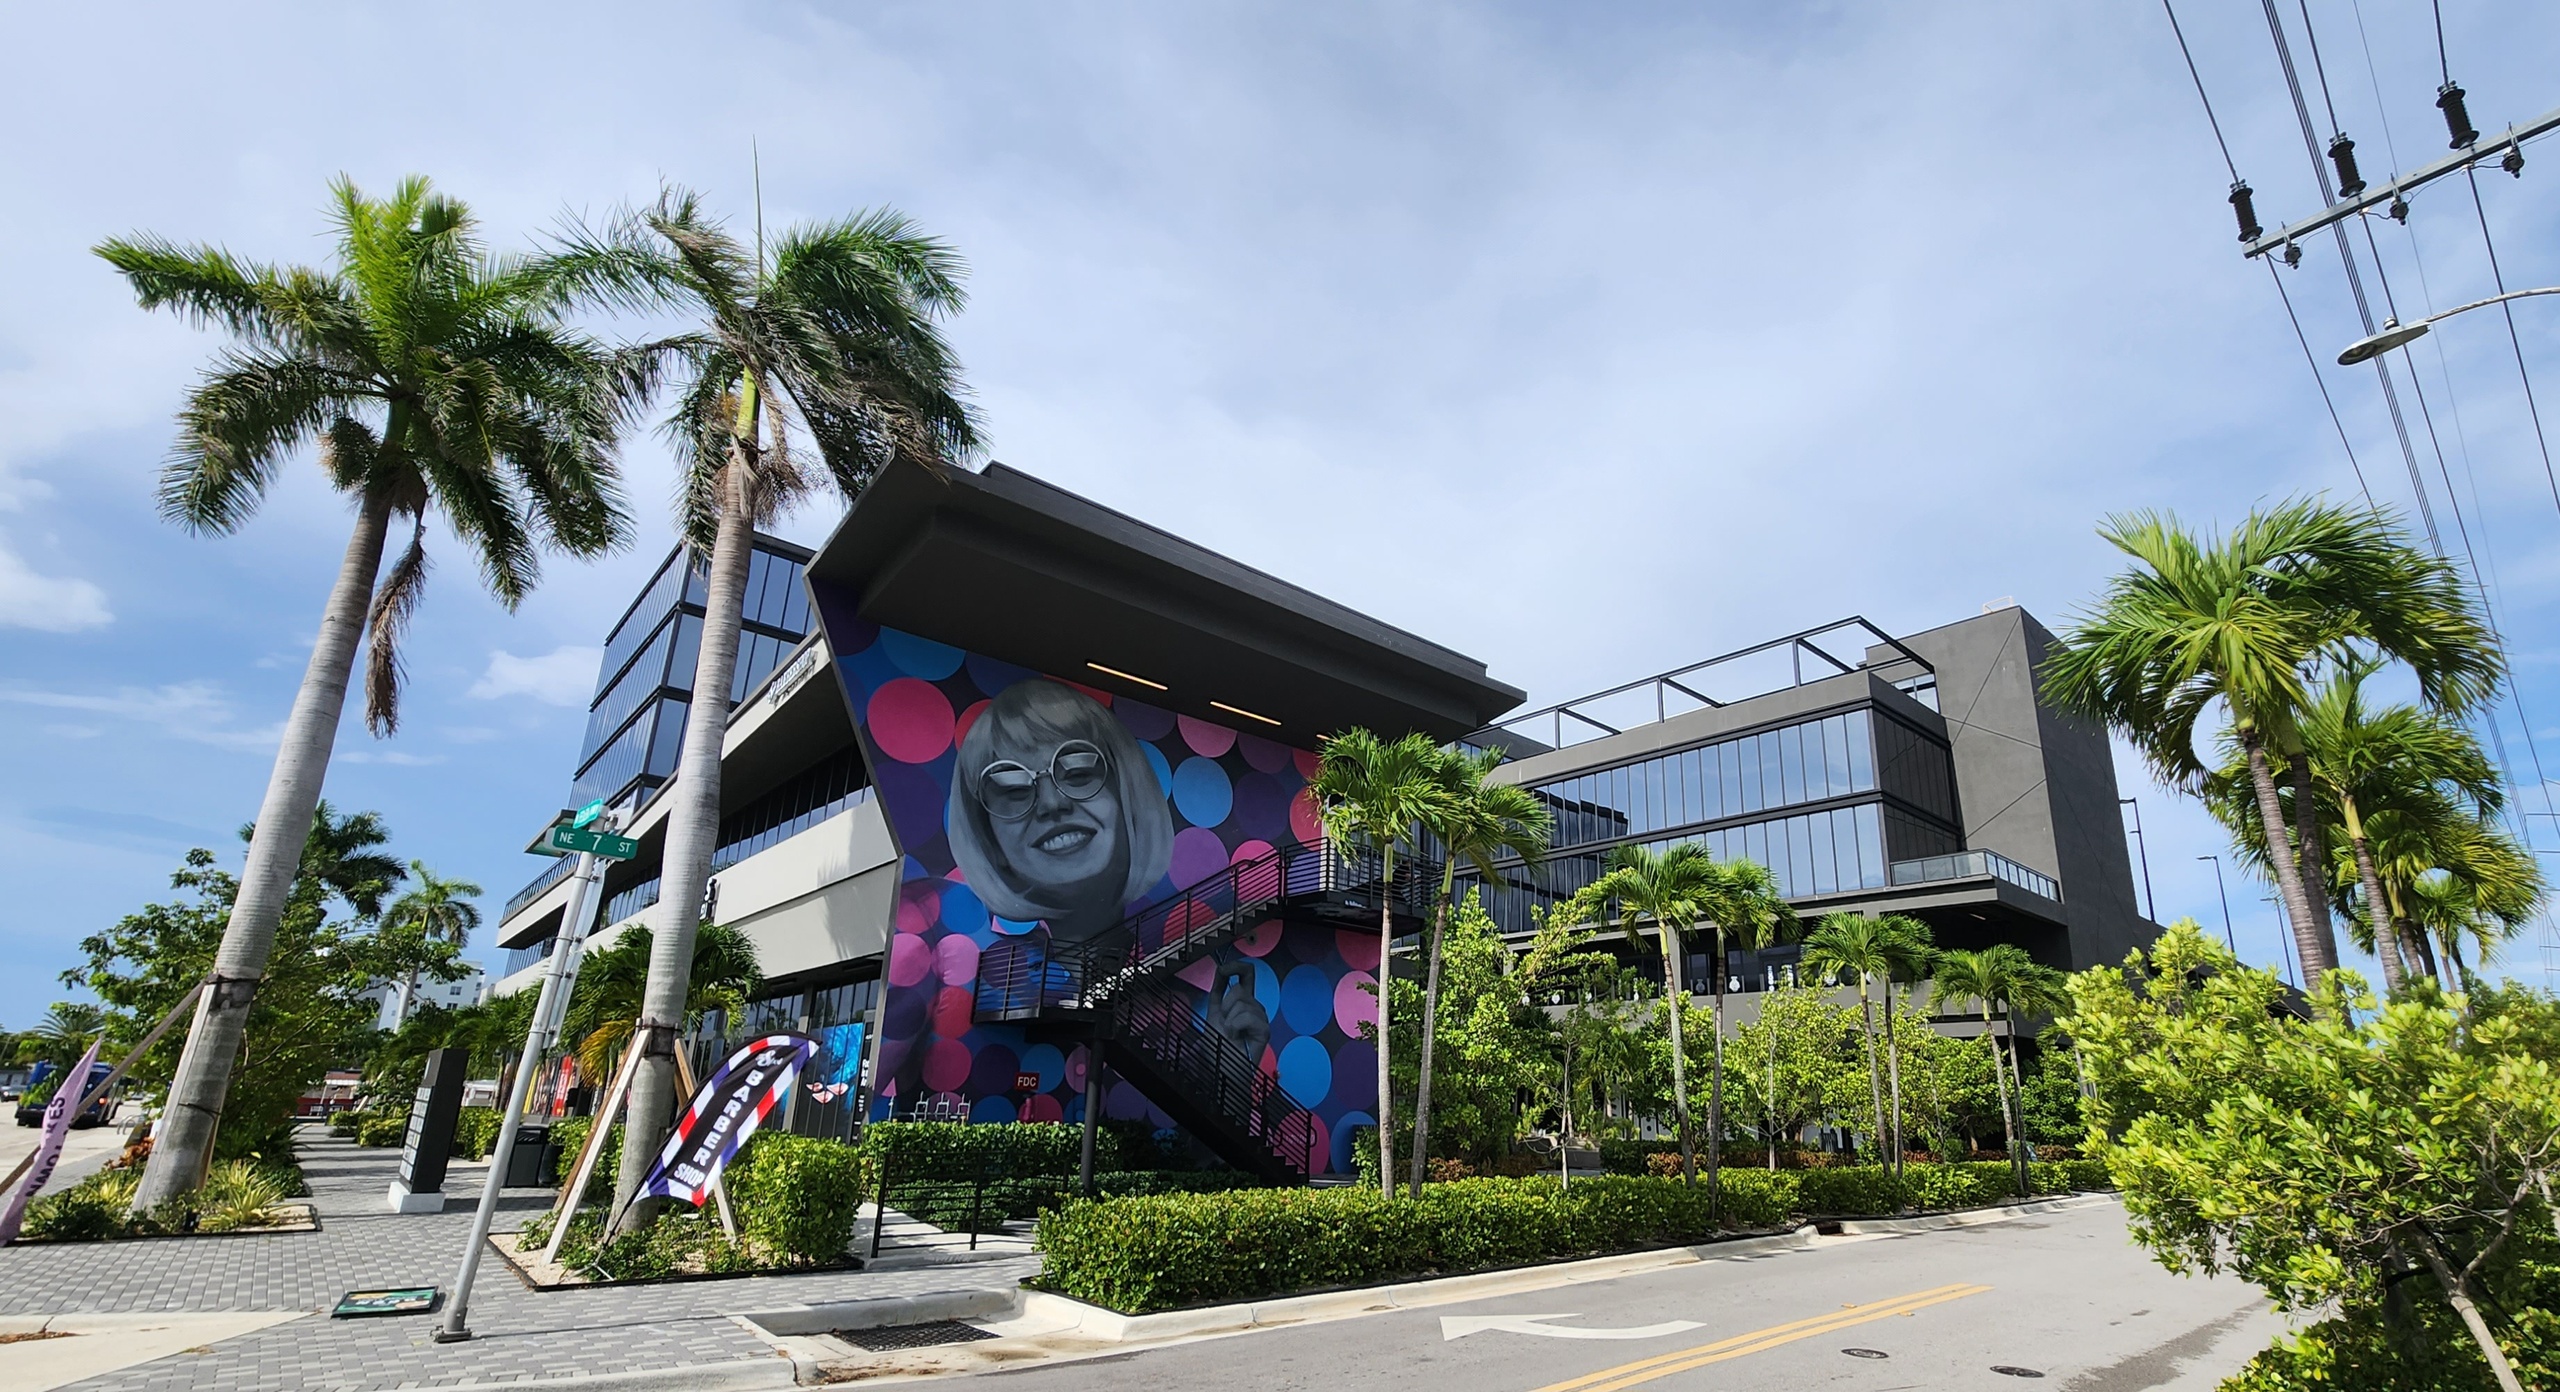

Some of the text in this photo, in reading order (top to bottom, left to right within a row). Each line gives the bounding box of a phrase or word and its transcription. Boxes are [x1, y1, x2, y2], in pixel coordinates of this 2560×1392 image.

[559, 831, 632, 853] NE 7 ST
[1017, 1076, 1037, 1087] FDC
[692, 1069, 765, 1167] BARBER
[673, 1162, 706, 1188] SHOP
